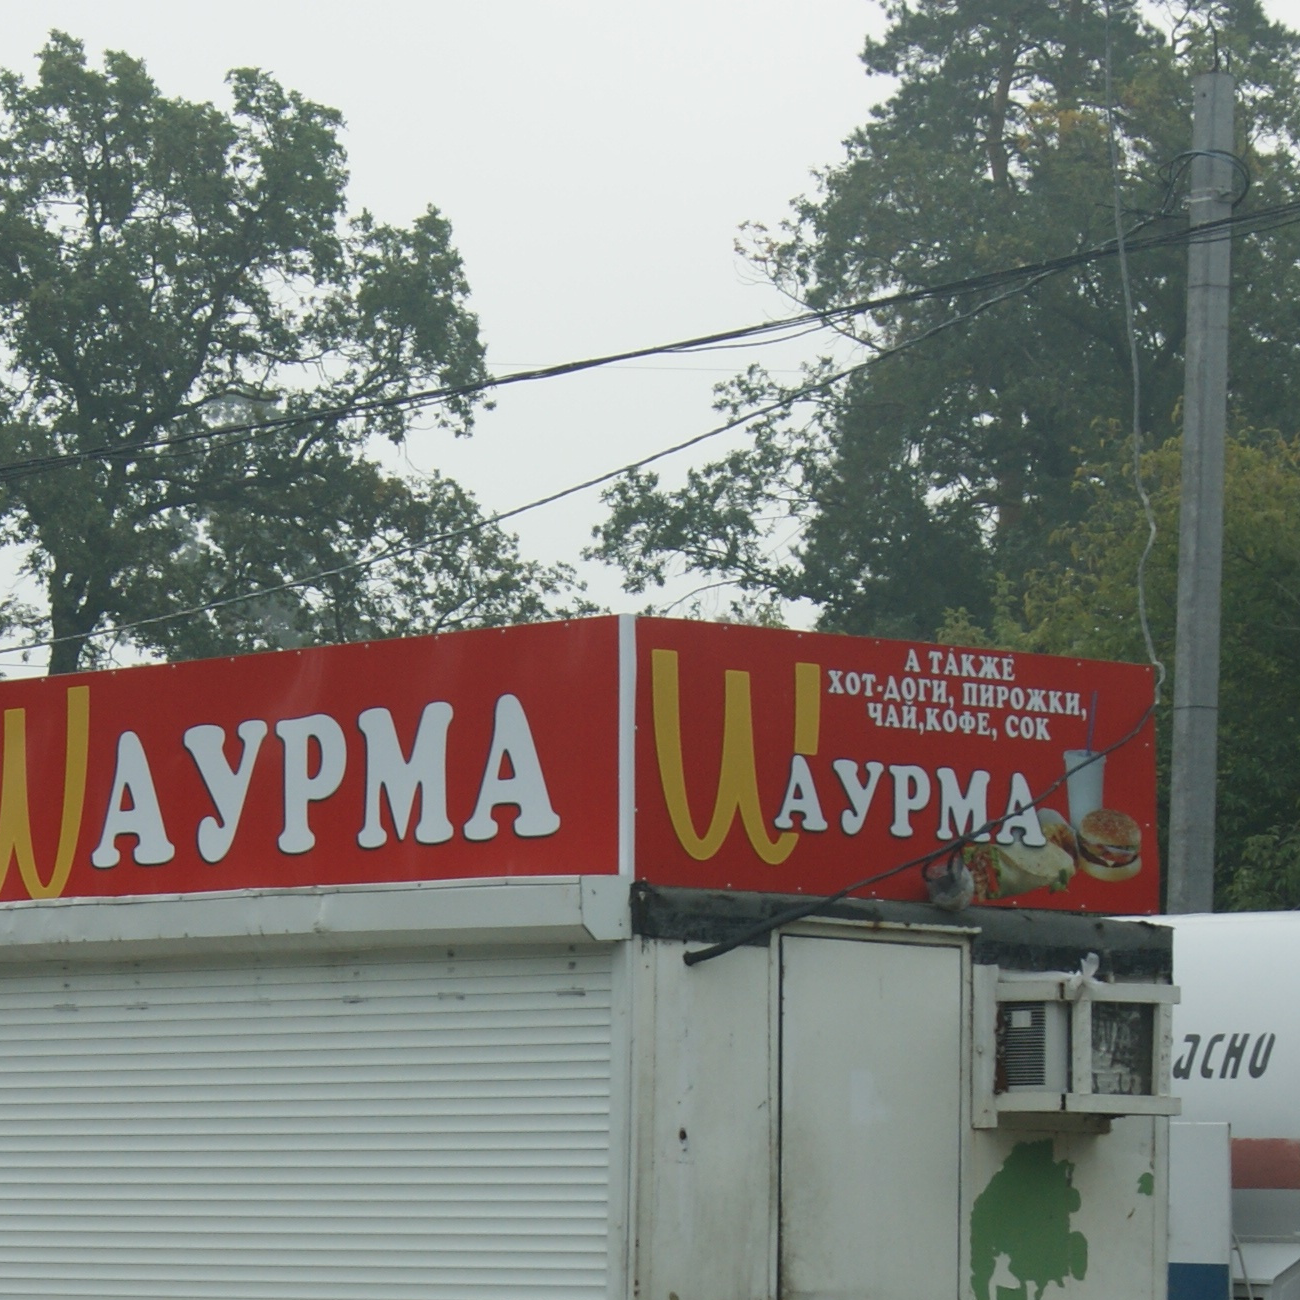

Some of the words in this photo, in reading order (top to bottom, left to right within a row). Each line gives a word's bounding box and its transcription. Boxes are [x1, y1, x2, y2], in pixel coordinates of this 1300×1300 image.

[904, 648, 921, 673] А
[928, 650, 1016, 682] ТАКЖЕ
[827, 669, 955, 709] ХОТ-ДОГИ,
[962, 682, 1088, 721] ПИРОЖКИ,
[1005, 715, 1052, 741] СОК
